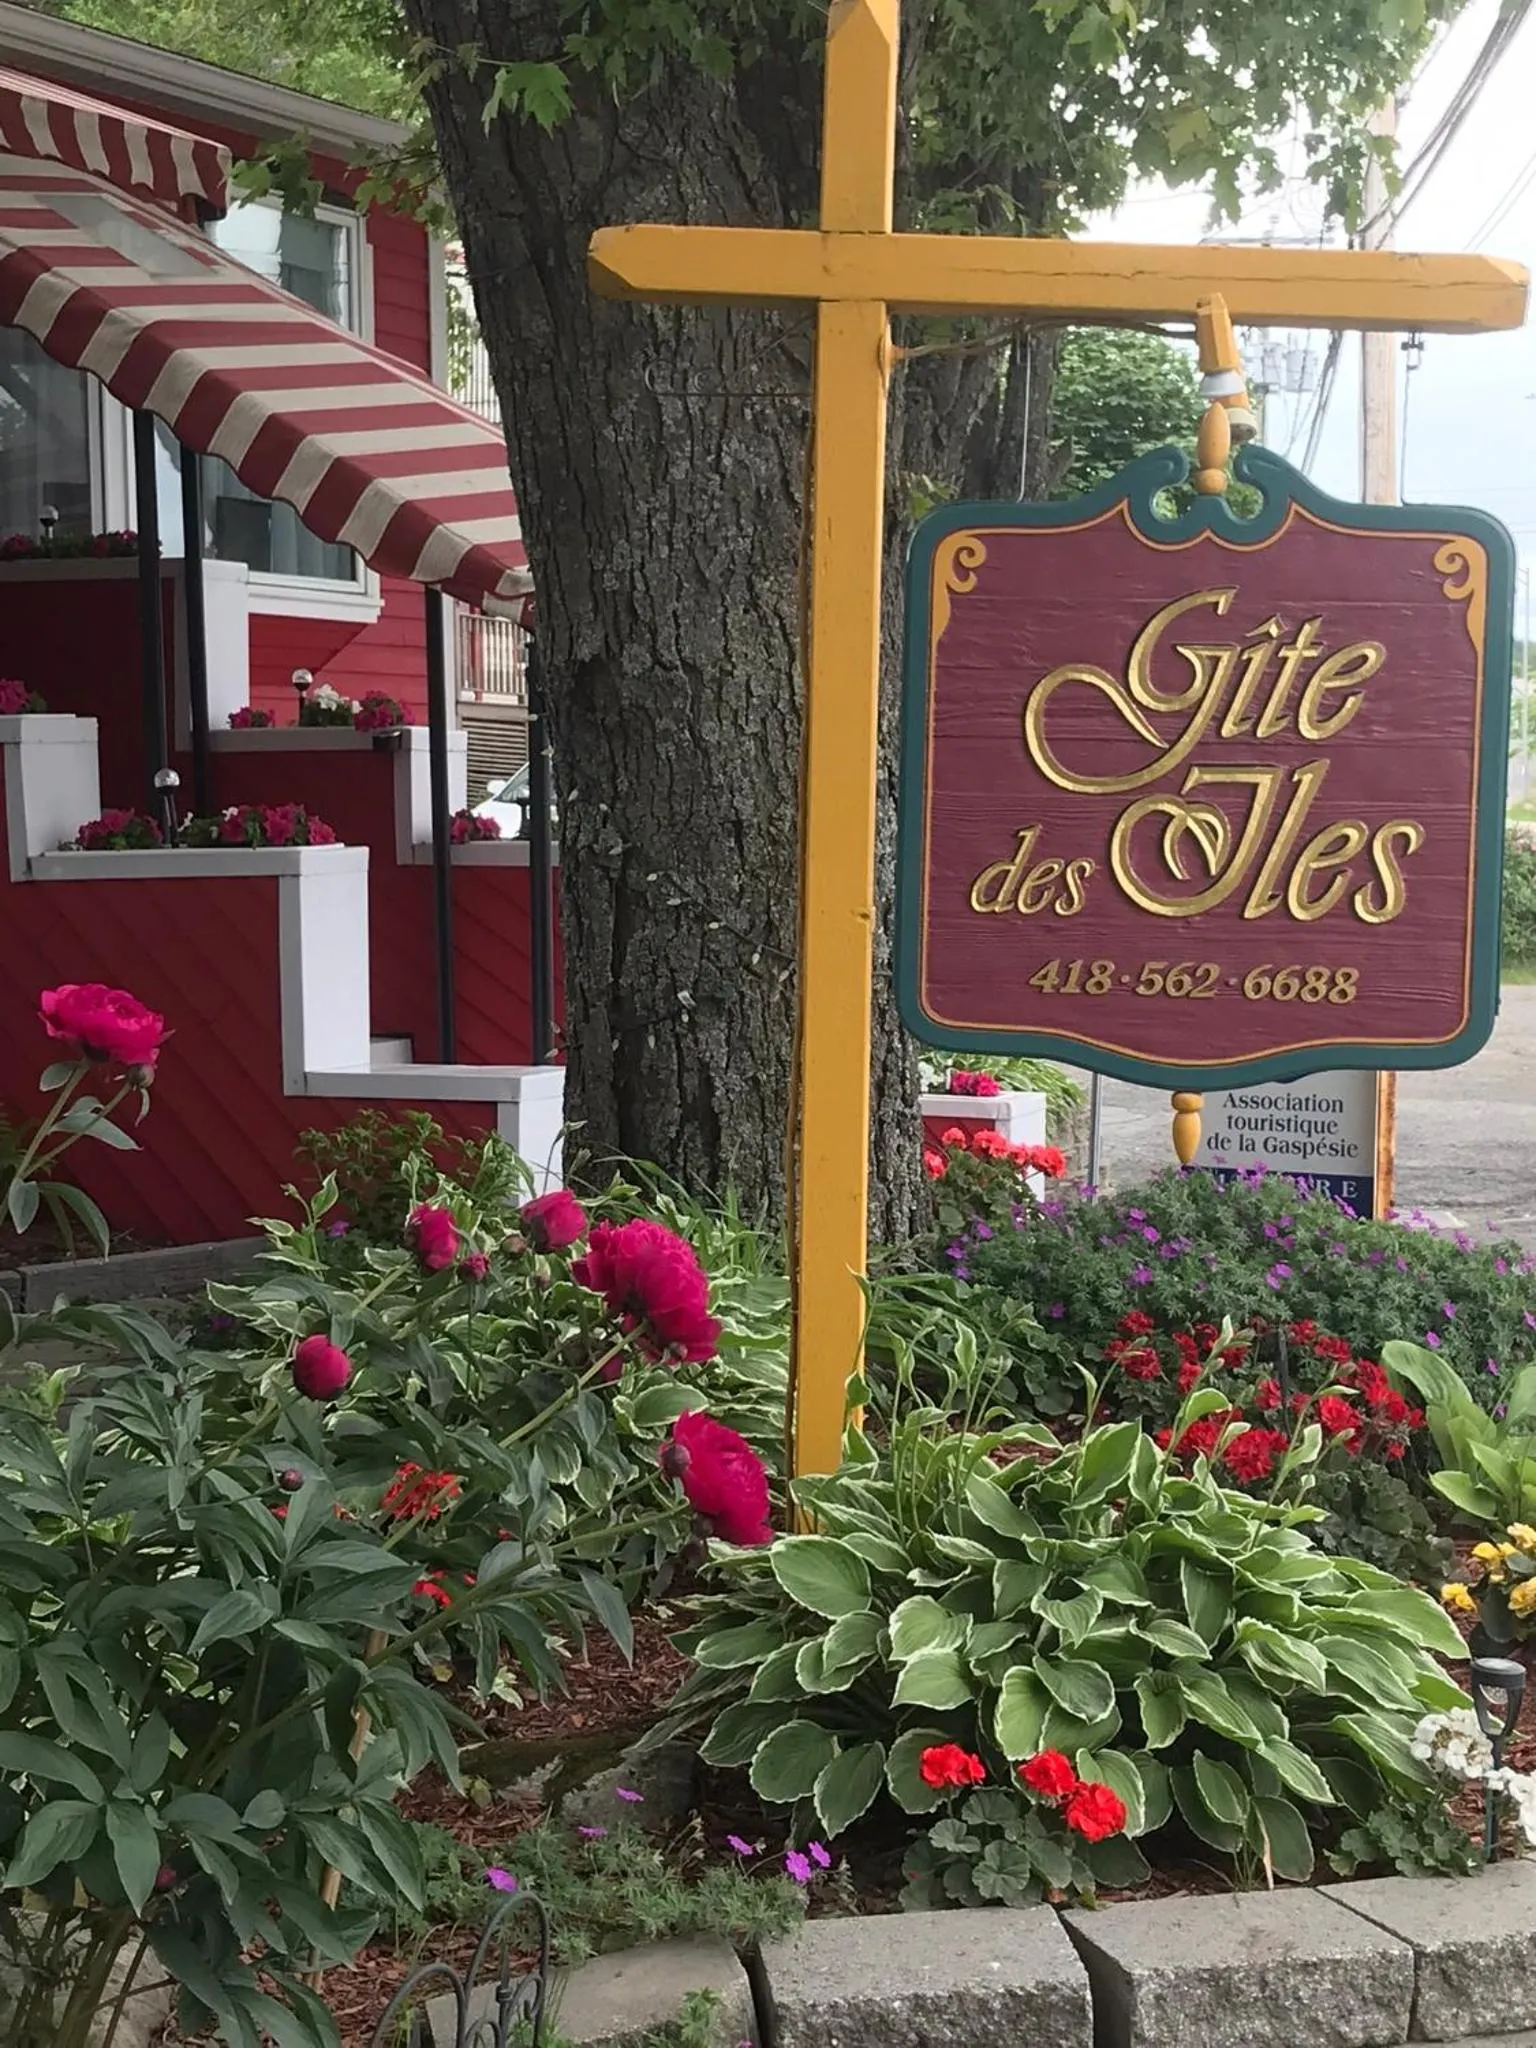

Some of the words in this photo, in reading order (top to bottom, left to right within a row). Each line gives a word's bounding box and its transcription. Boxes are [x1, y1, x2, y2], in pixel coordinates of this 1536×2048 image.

[1023, 584, 1388, 794] Gîte
[969, 824, 1096, 918] des
[1222, 1091, 1345, 1114] Association
[1226, 1114, 1339, 1138] touristique
[1206, 1132, 1232, 1151] de
[1239, 1133, 1256, 1153] la
[1262, 1135, 1360, 1160] Gaspésie
